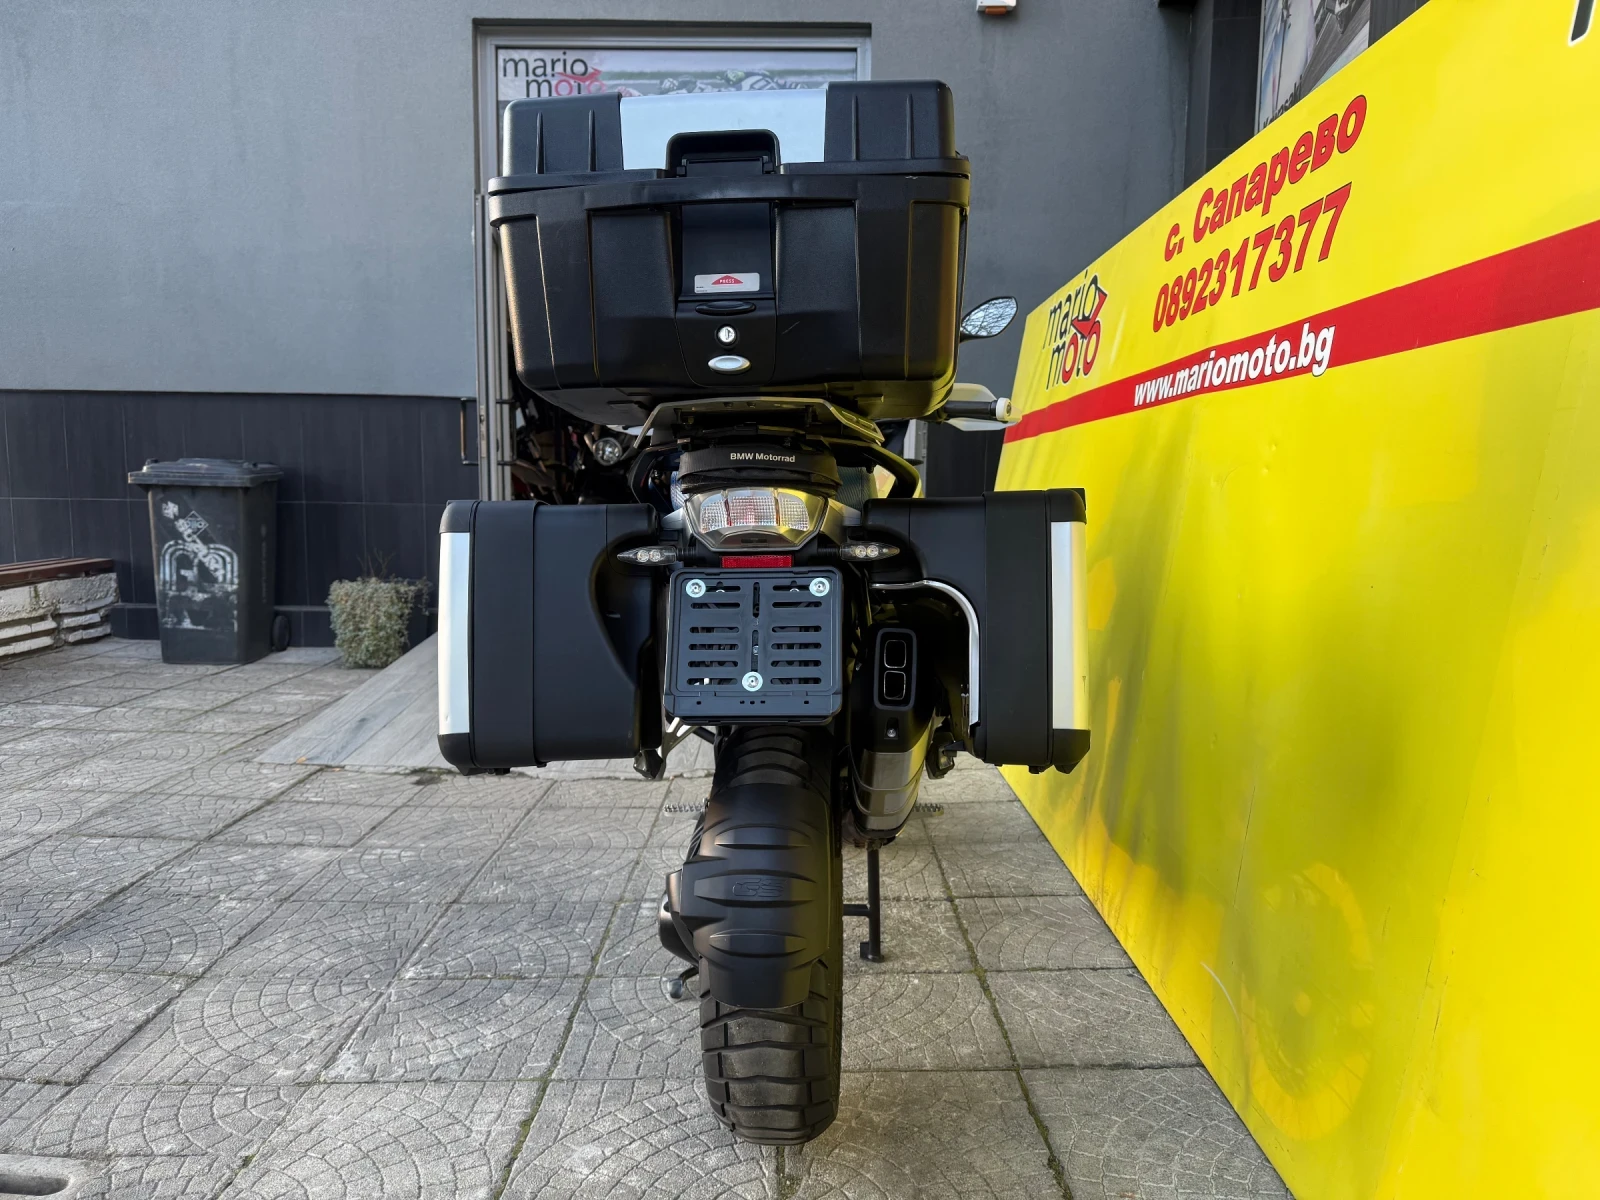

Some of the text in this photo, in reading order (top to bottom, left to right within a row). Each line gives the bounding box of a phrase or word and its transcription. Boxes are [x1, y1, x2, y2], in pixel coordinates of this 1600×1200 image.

[502, 51, 588, 78] mario
[526, 79, 606, 98] moto
[1193, 94, 1368, 244] Сапарево
[1152, 181, 1353, 333] 0892317377
[1042, 268, 1098, 350] mario
[1046, 319, 1102, 390] moto
[1133, 321, 1336, 407] www.mariomoto.bg
[730, 452, 796, 463] BMW Motorrad
[732, 877, 786, 898] GS
